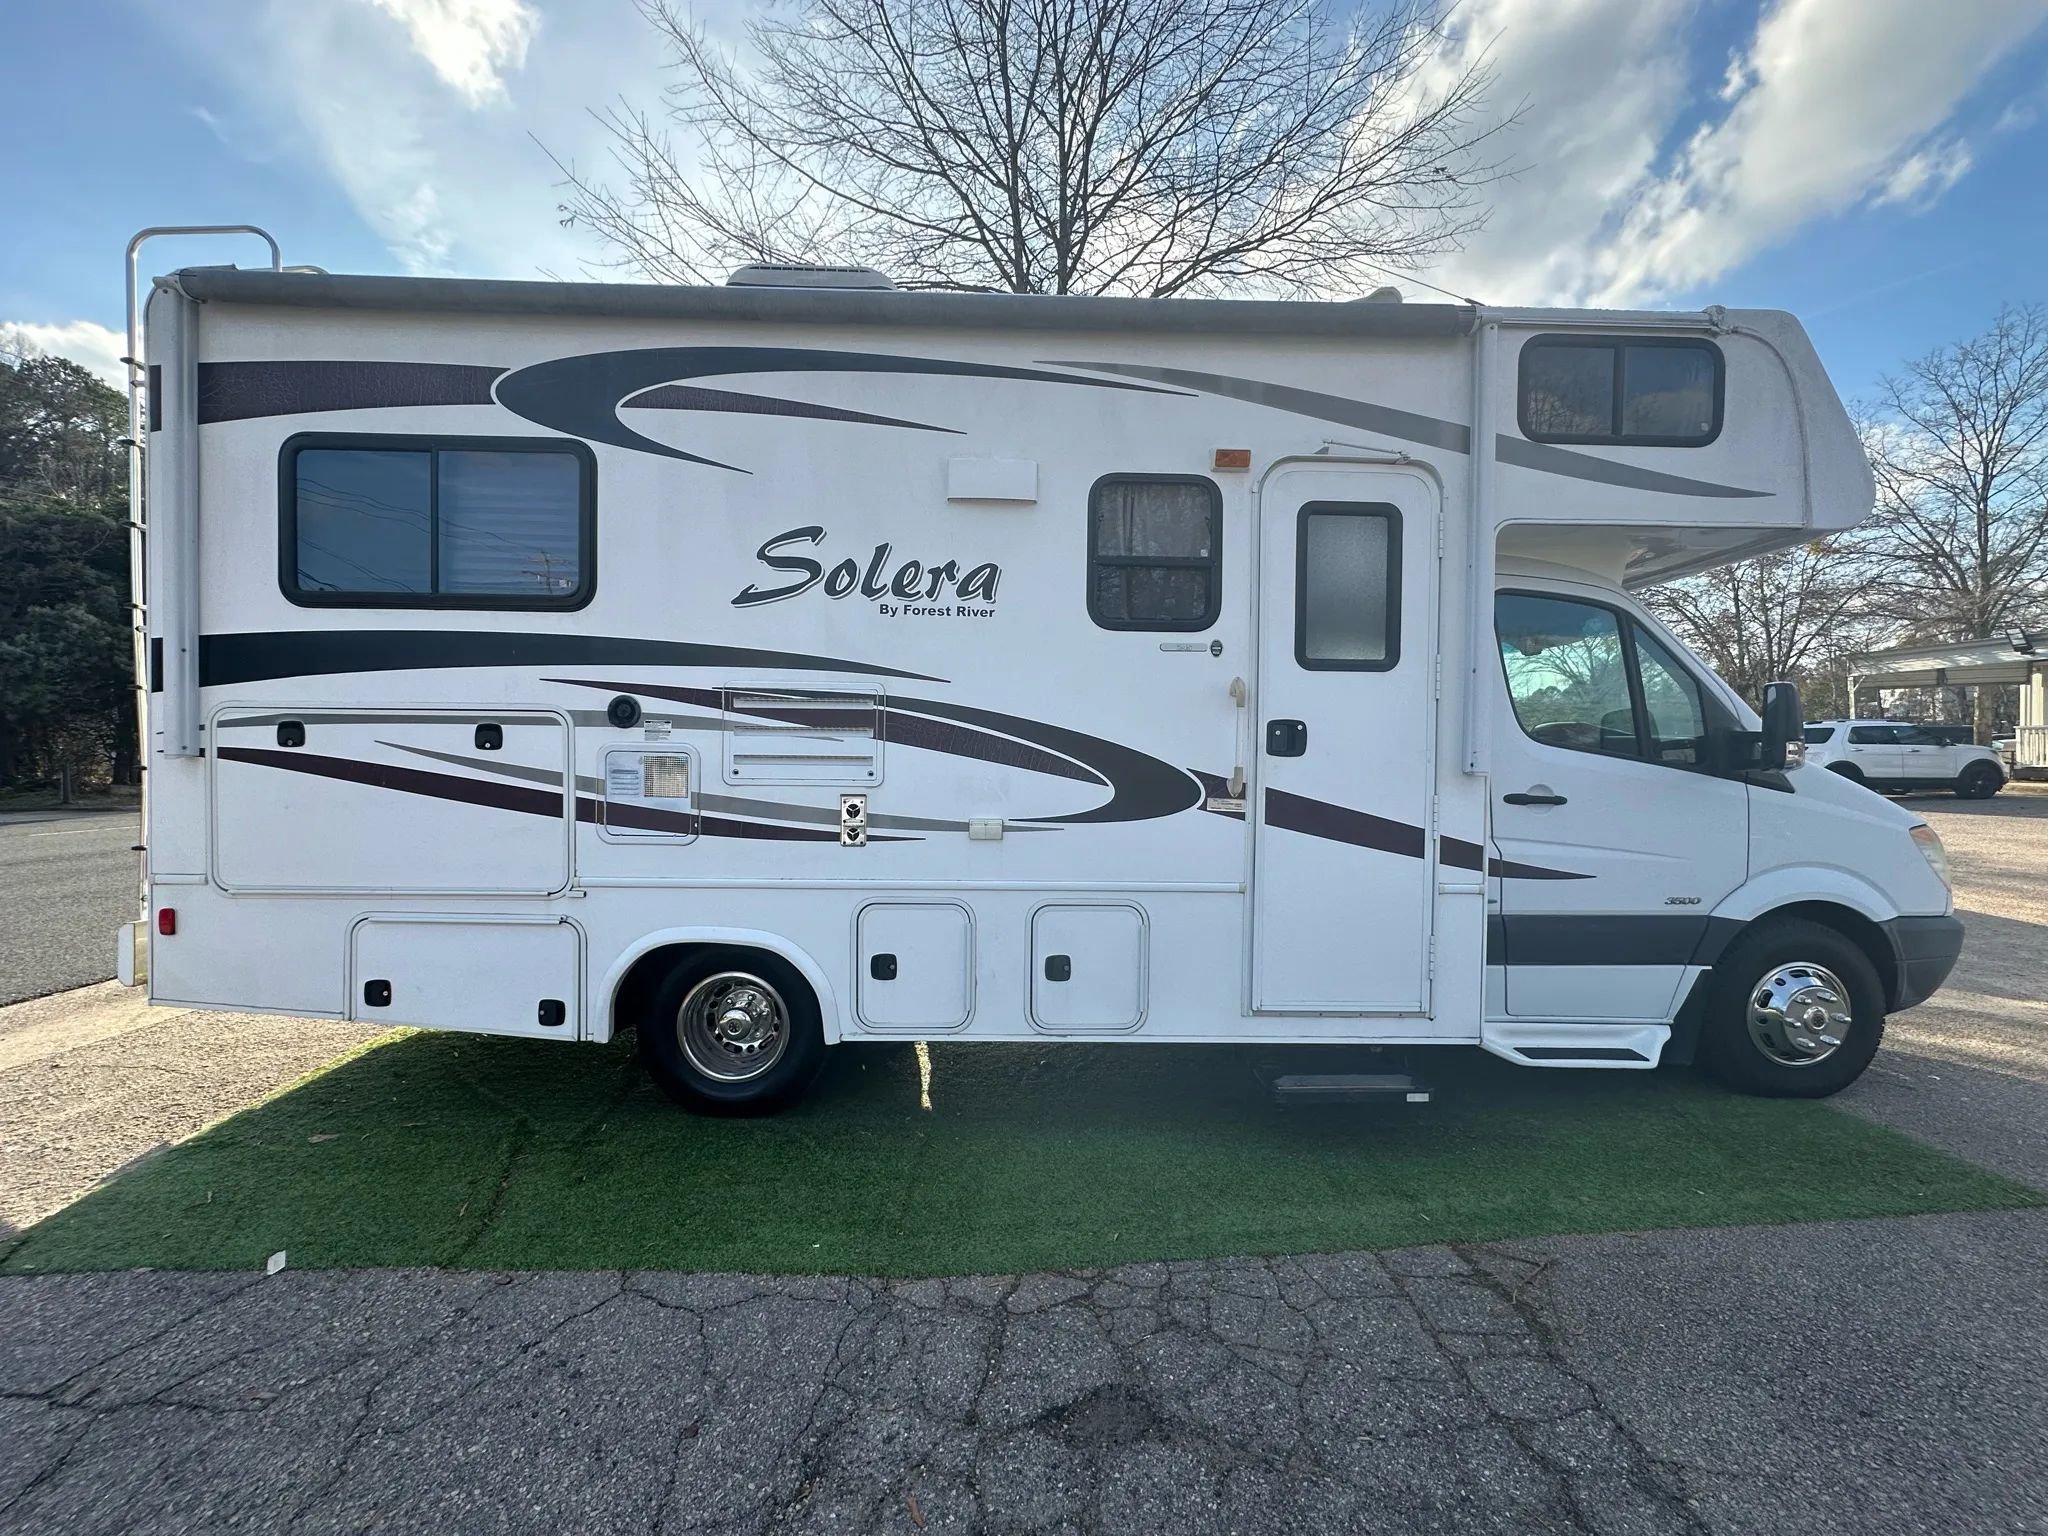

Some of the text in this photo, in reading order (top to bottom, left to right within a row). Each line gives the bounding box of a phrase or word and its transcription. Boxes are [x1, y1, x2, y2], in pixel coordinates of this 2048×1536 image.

[730, 525, 1003, 608] Solera
[879, 604, 995, 618] By Forest River
[1664, 896, 1702, 906] 3500
